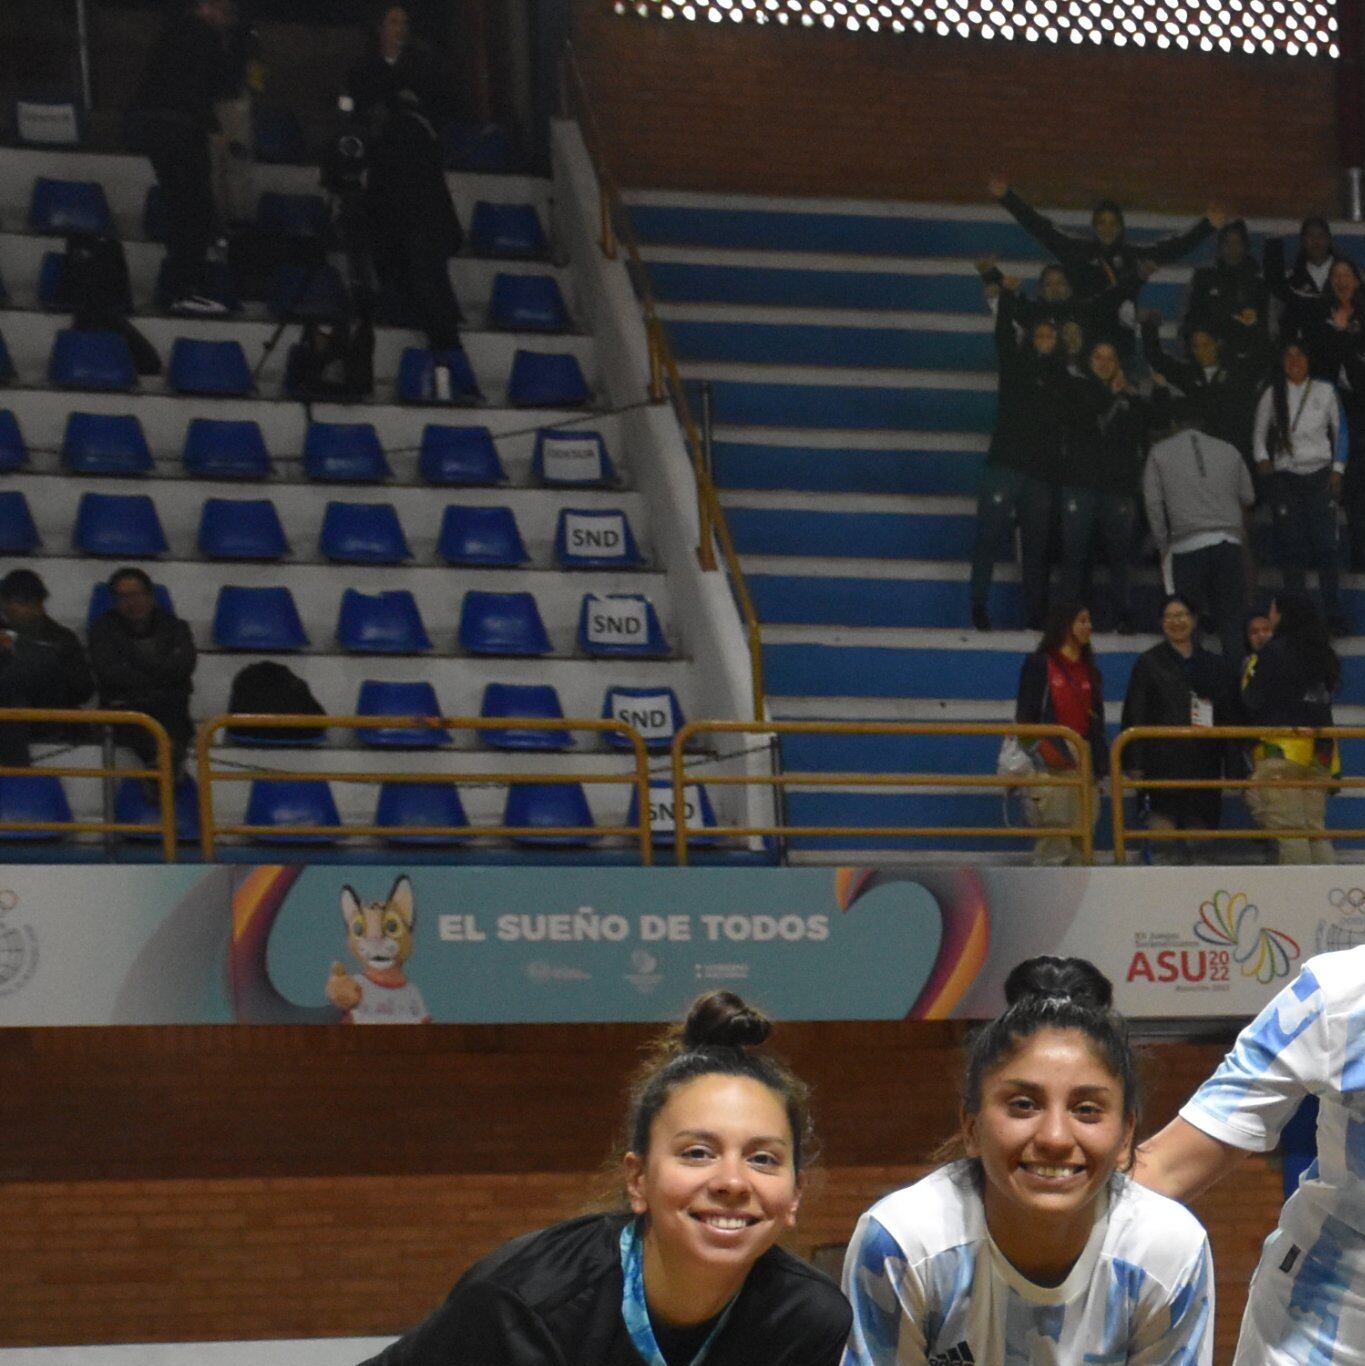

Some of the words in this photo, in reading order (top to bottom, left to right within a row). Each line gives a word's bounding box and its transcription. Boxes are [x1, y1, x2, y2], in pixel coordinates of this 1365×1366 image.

[572, 529, 619, 547] SND
[592, 616, 640, 634] SND
[619, 710, 666, 728] SND
[438, 915, 486, 941] EL
[498, 907, 628, 941] SUEÑO
[640, 914, 691, 941] DE
[699, 913, 830, 941] TODOS
[1126, 950, 1208, 983] ASU
